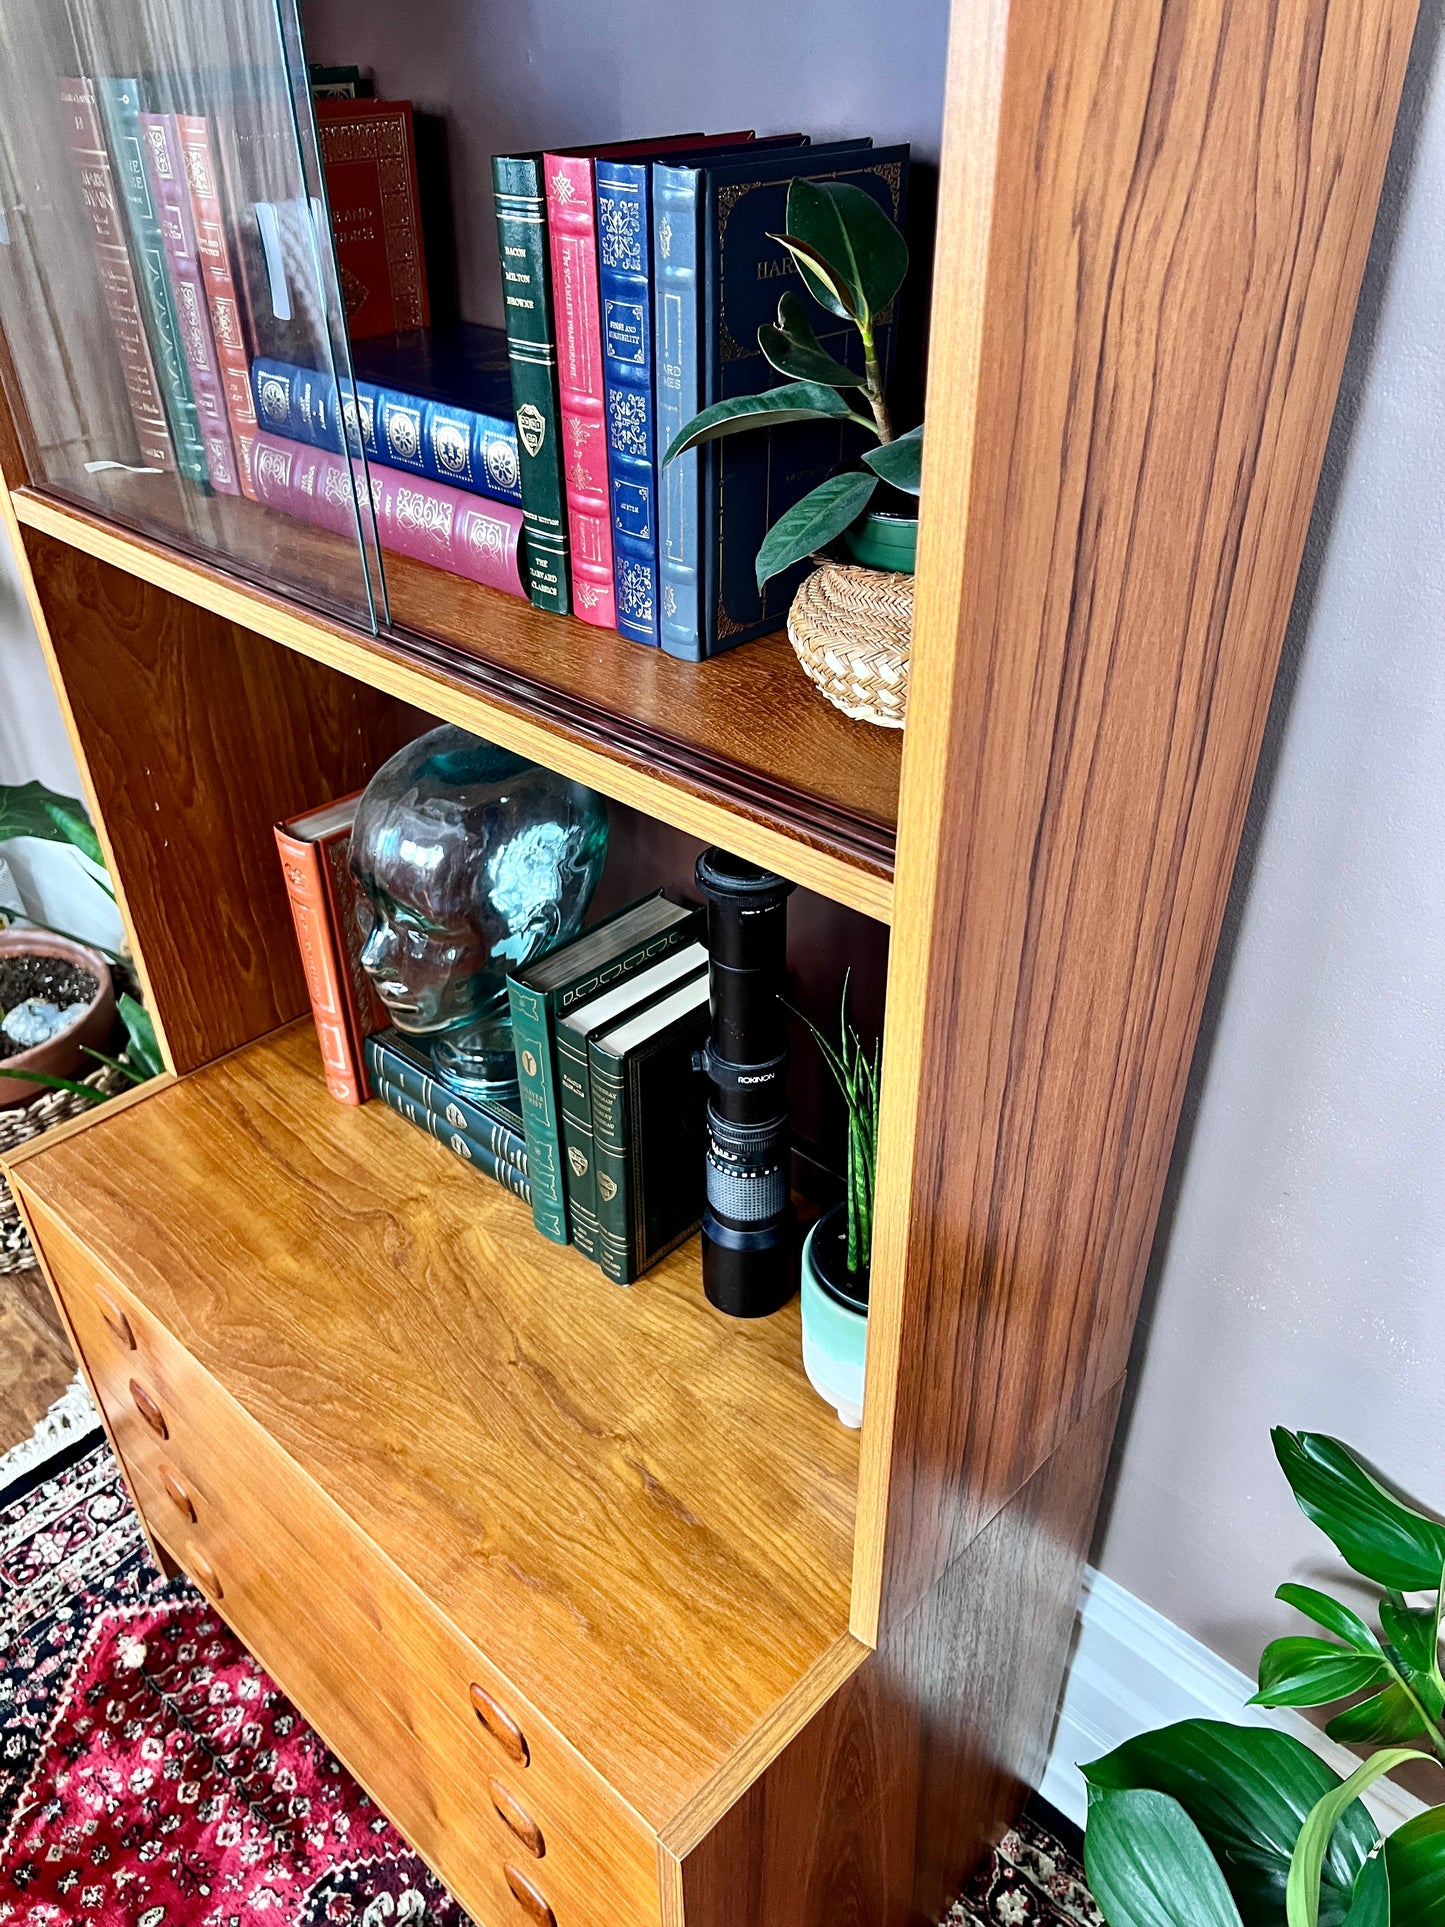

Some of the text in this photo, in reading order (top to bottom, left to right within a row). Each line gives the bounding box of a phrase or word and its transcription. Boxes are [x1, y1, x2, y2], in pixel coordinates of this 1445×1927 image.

[504, 246, 526, 258] BACON
[756, 256, 798, 281] HAR
[505, 271, 531, 284] MILTON
[563, 268, 573, 318] SCARLET
[567, 320, 577, 379] PIMPERNEL
[664, 363, 681, 378] ARD
[738, 1072, 776, 1085] ROKINON
